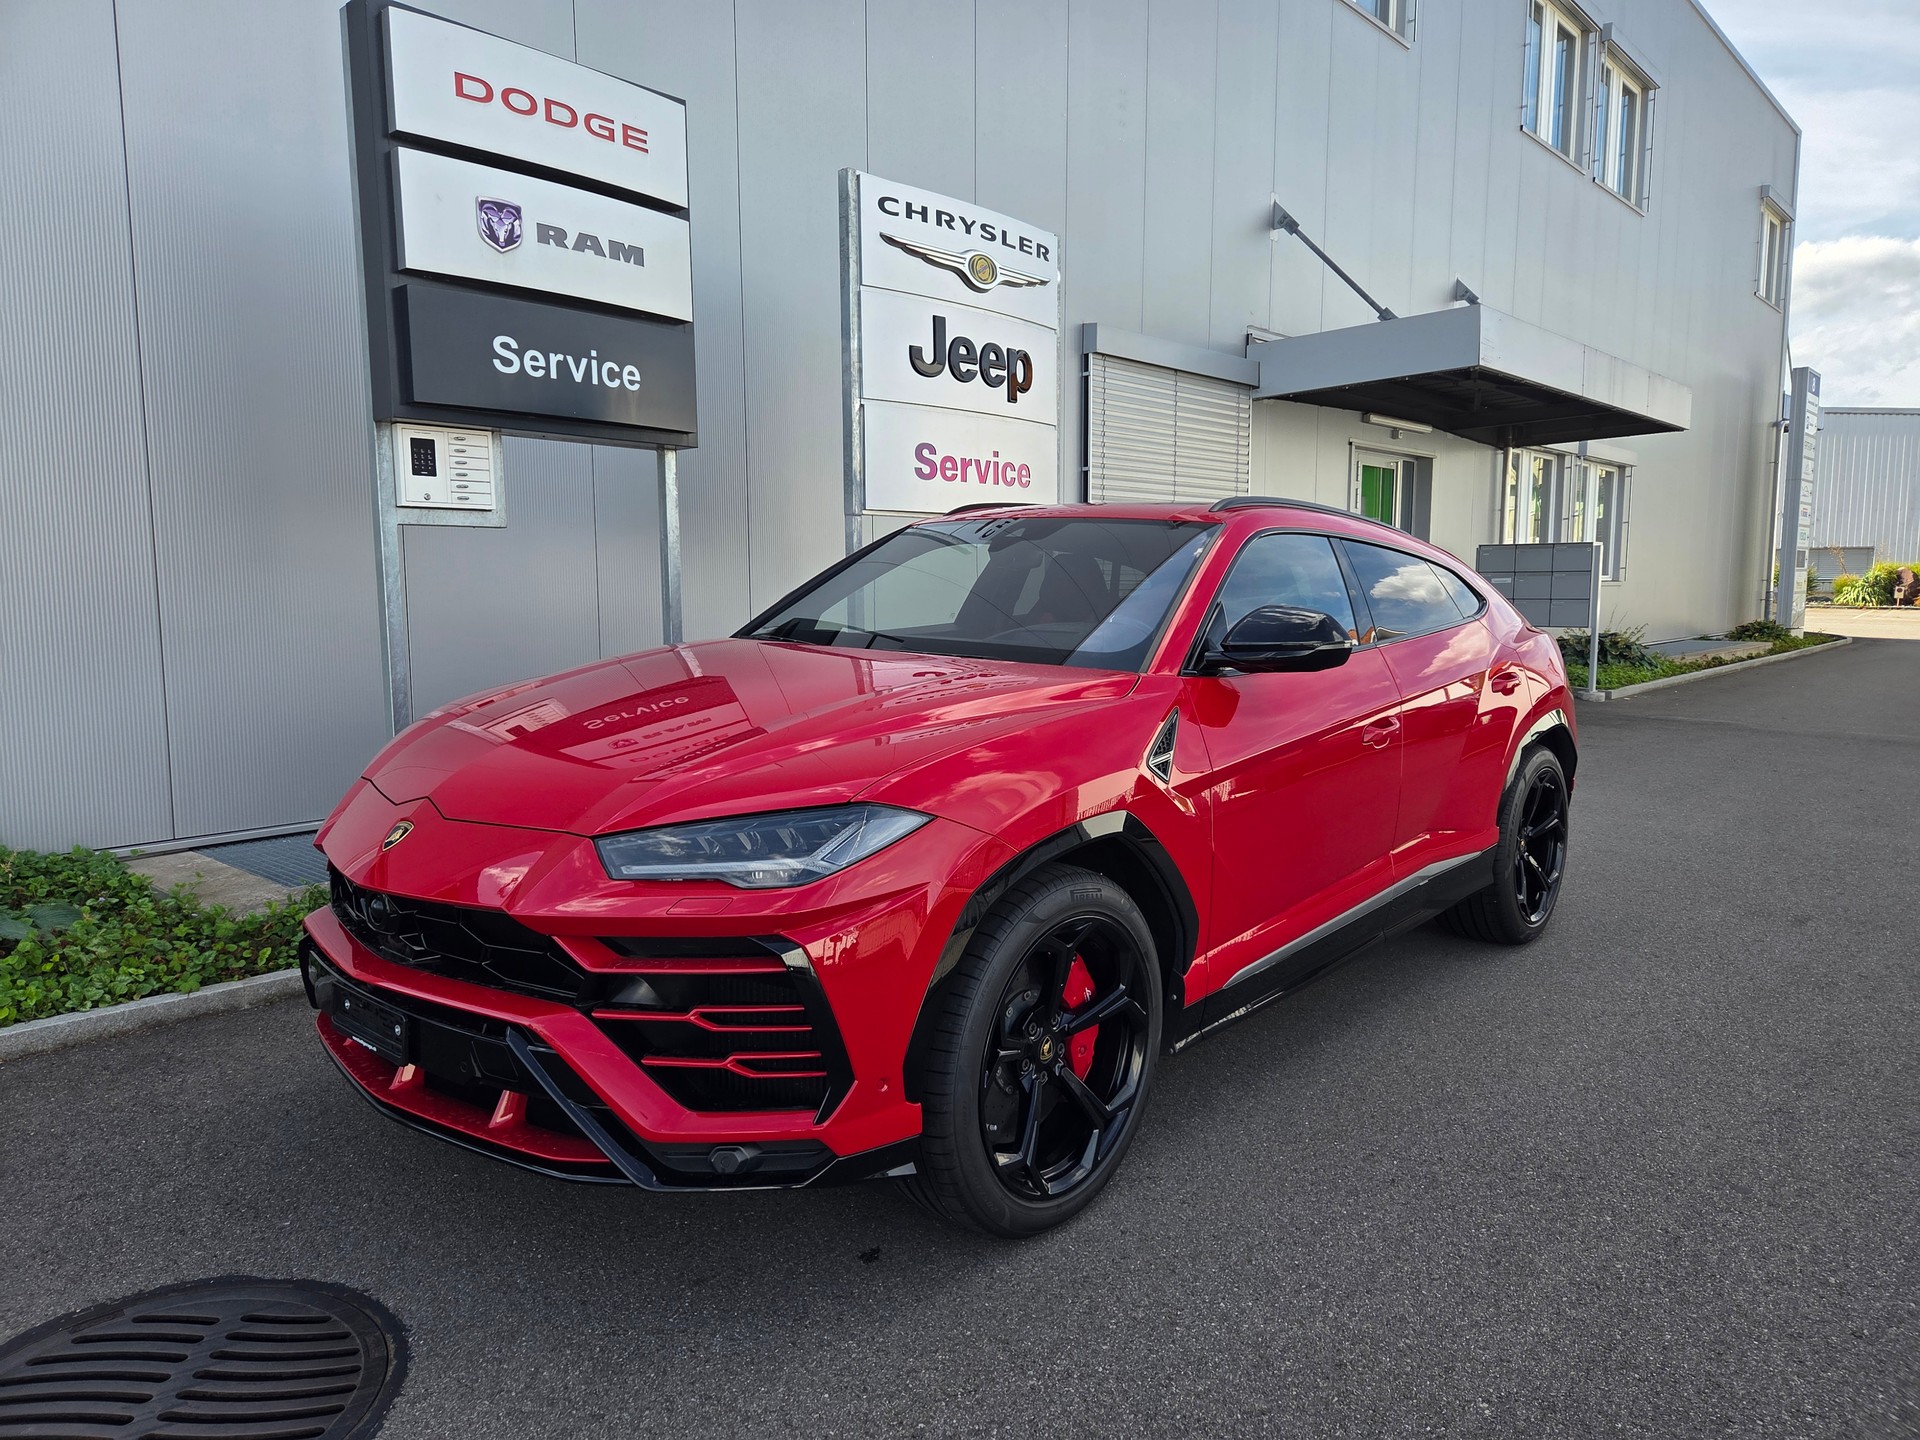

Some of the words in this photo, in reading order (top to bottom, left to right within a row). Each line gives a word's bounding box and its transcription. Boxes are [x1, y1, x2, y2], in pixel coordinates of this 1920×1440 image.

[454, 71, 649, 154] DODGE
[536, 221, 645, 268] RAM
[877, 196, 1050, 262] CHRYSLER
[492, 335, 641, 391] Service
[909, 315, 1033, 403] Jeep
[914, 442, 1031, 488] Service
[1069, 887, 1104, 903] PIRELLI
